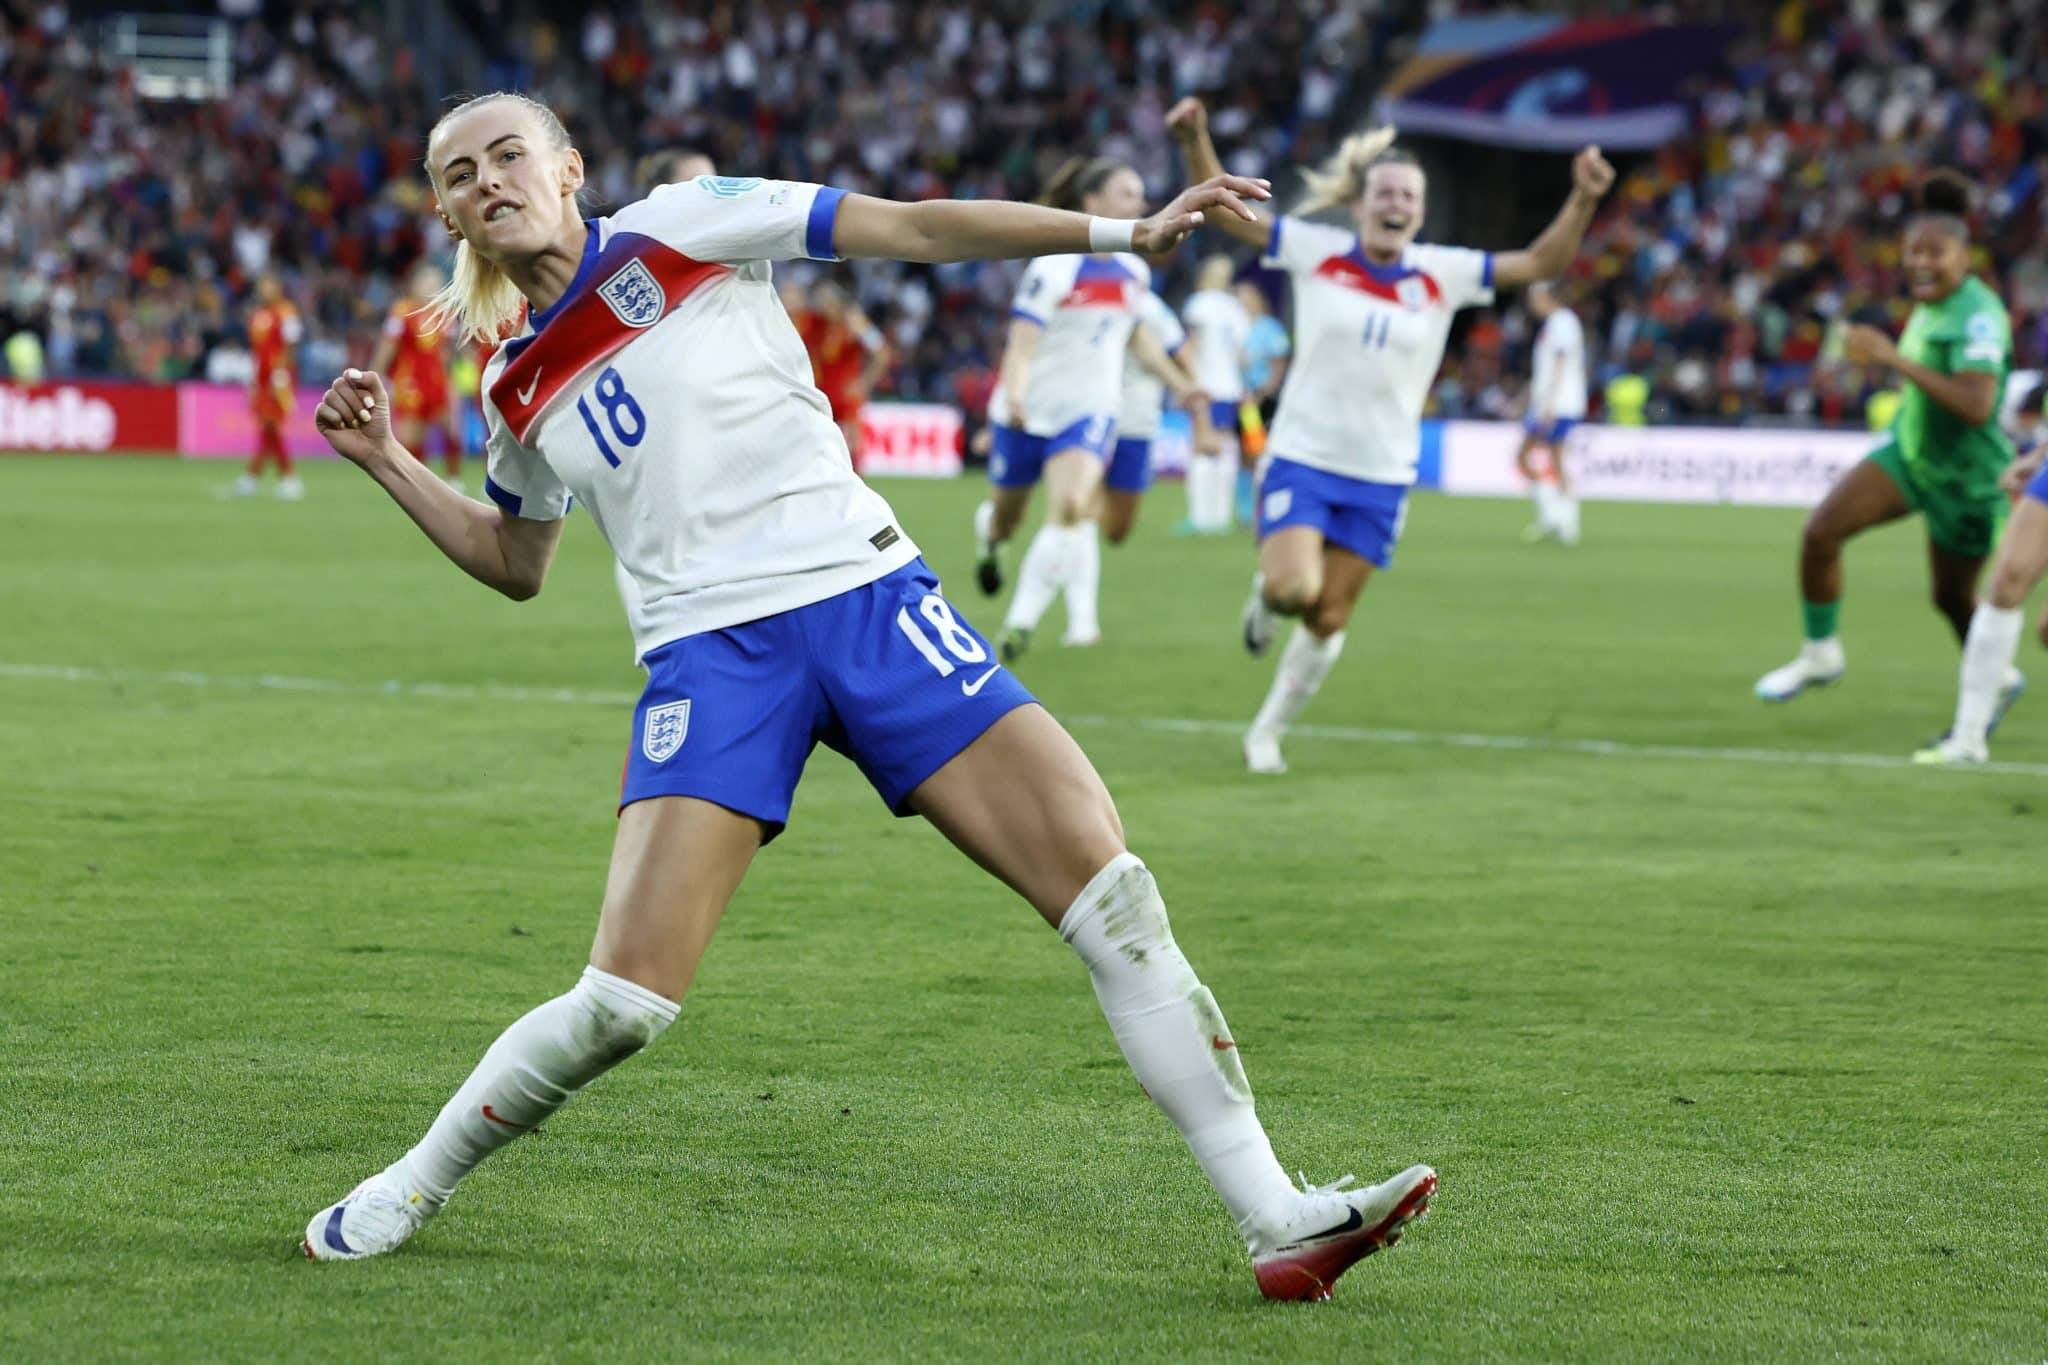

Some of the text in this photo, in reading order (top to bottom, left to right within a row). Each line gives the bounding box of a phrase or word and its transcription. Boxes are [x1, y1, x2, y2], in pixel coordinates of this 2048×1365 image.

[1361, 312, 1390, 348] 11
[576, 366, 647, 470] 18
[896, 593, 988, 678] 18
